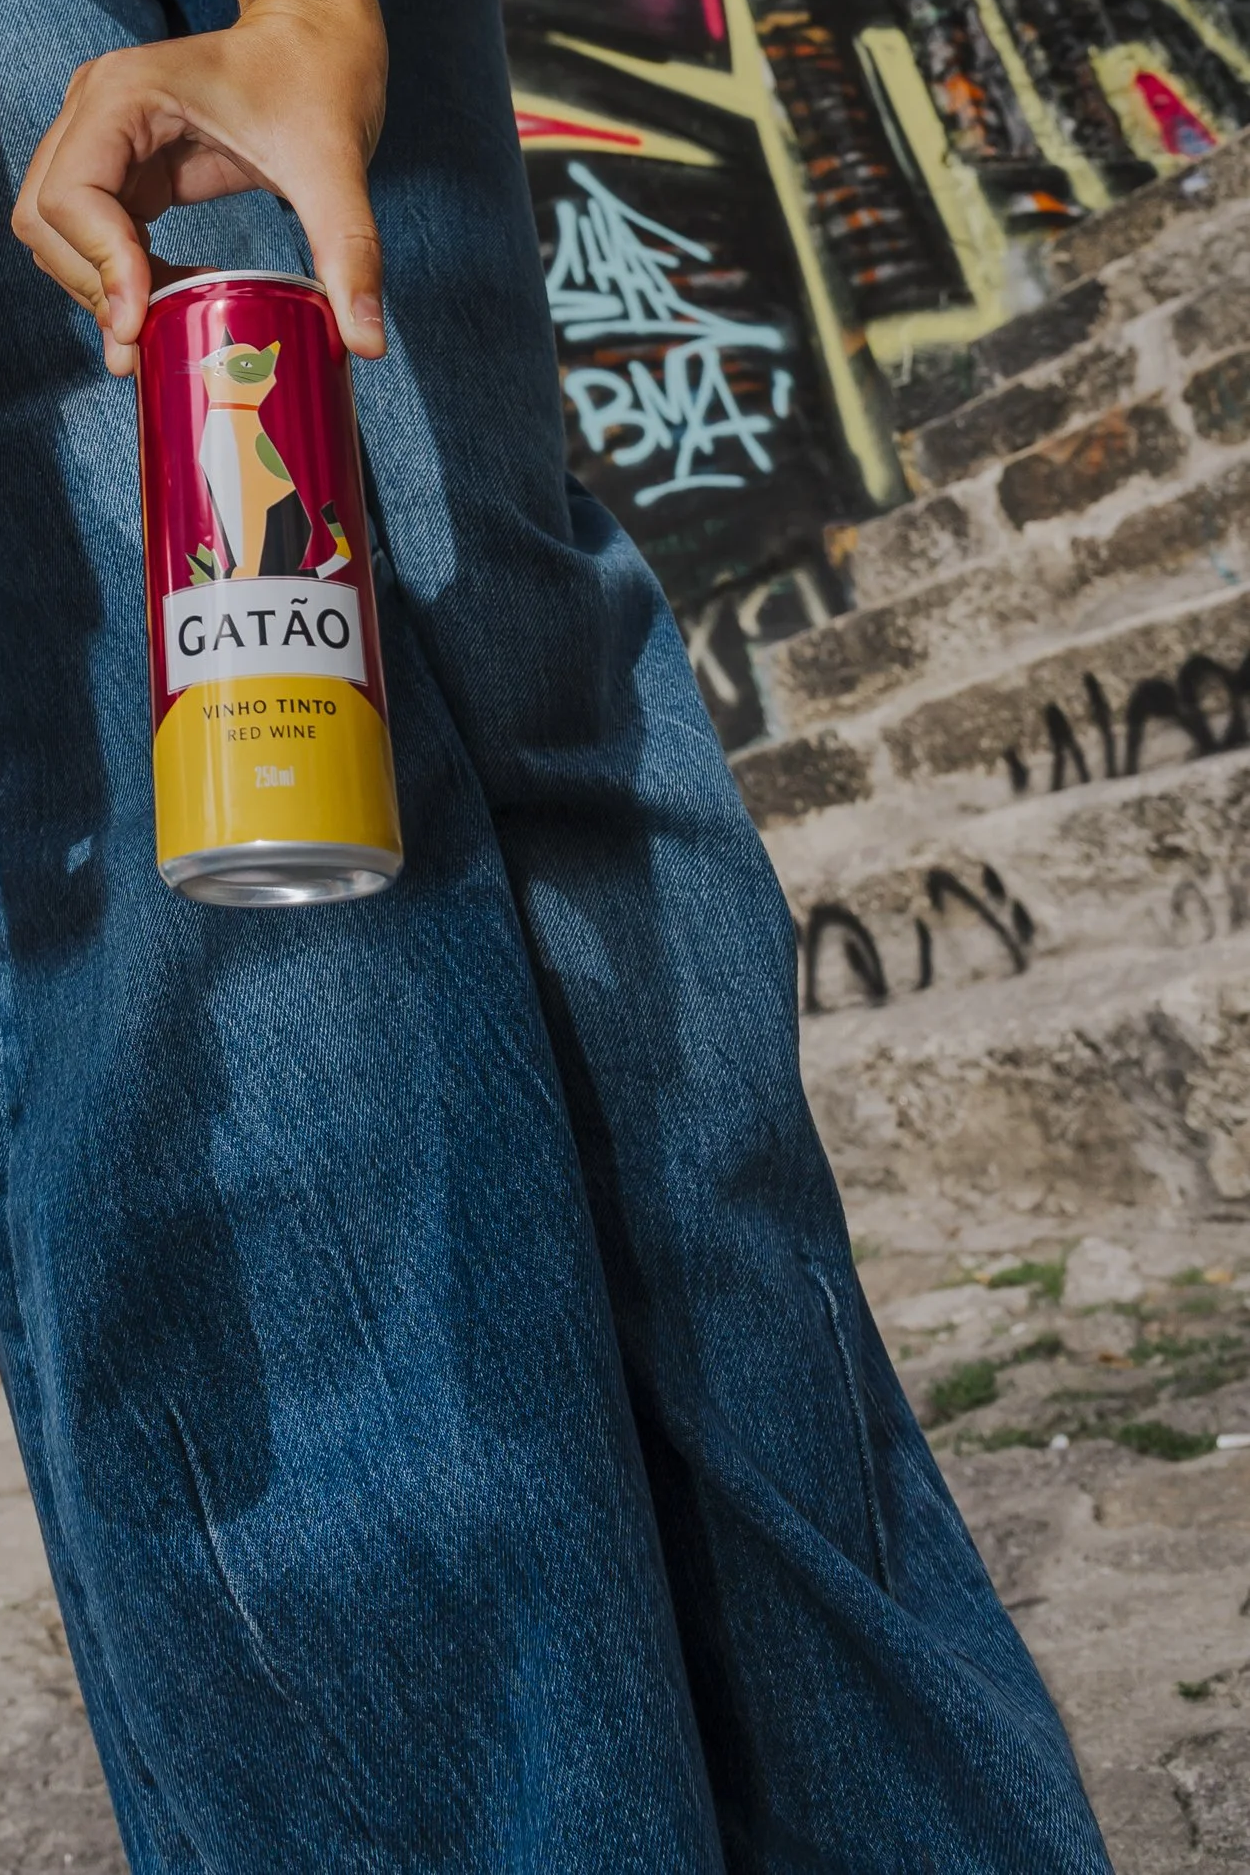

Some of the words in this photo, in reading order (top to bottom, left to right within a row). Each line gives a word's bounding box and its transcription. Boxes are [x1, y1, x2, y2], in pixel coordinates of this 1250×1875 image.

[178, 597, 351, 657] GATÃO
[203, 699, 267, 720] VINHO
[276, 698, 337, 716] TINTO
[227, 726, 261, 742] RED
[269, 724, 317, 739] WINE
[253, 764, 296, 789] 250ml
